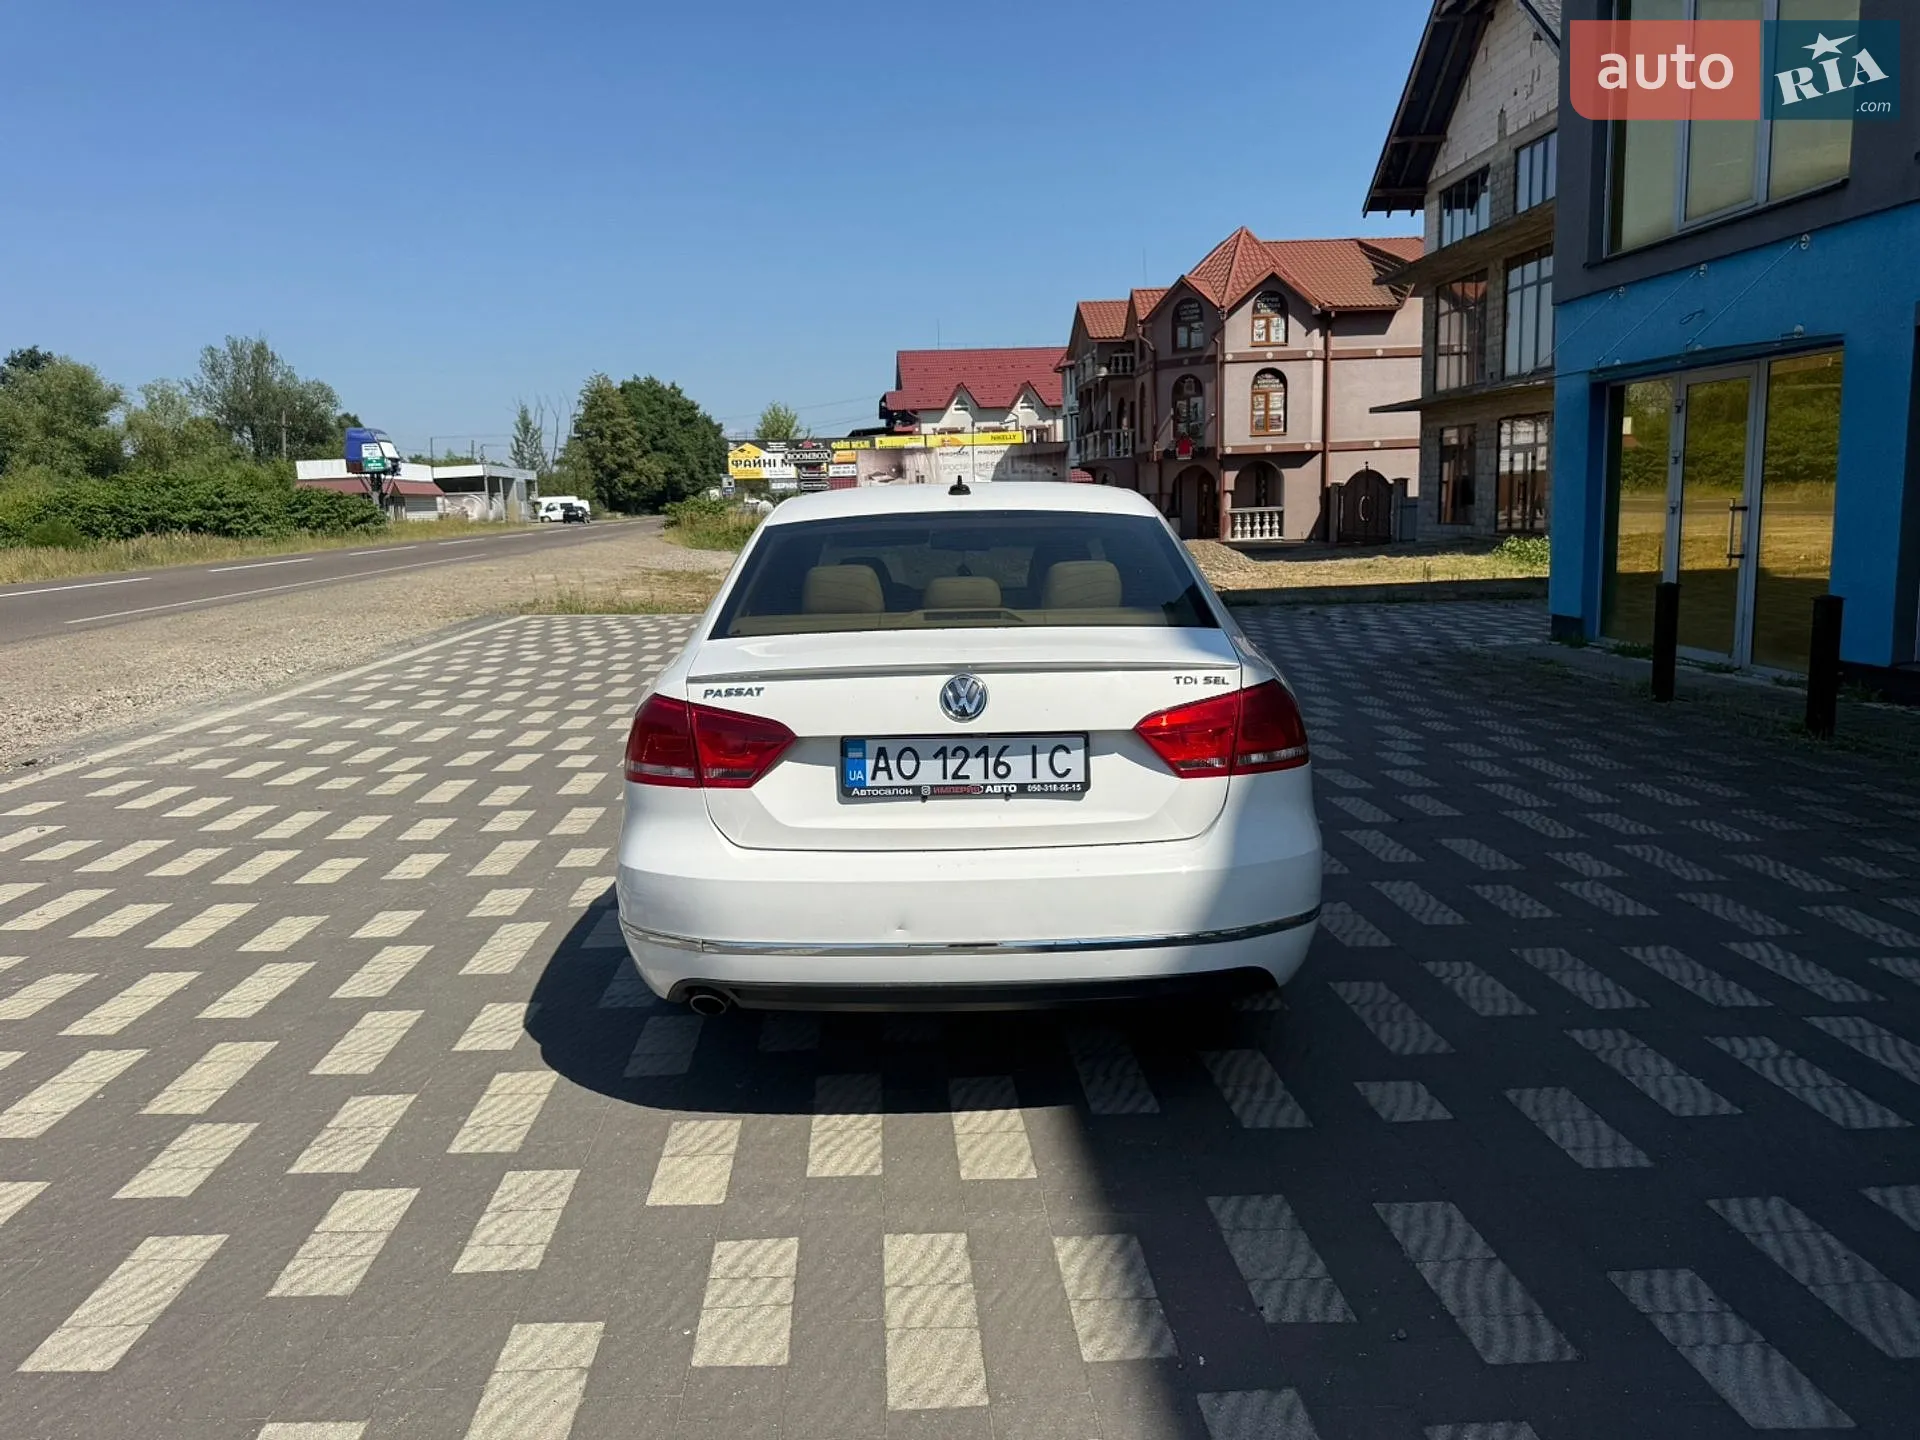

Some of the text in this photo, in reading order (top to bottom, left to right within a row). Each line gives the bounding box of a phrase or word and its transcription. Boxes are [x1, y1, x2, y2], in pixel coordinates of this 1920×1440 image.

[731, 456, 776, 468] ФАЙНІ
[1203, 676, 1230, 685] SEL
[703, 686, 765, 699] PASSAT
[870, 743, 1072, 781] AO 1216 IC
[849, 770, 865, 781] UA
